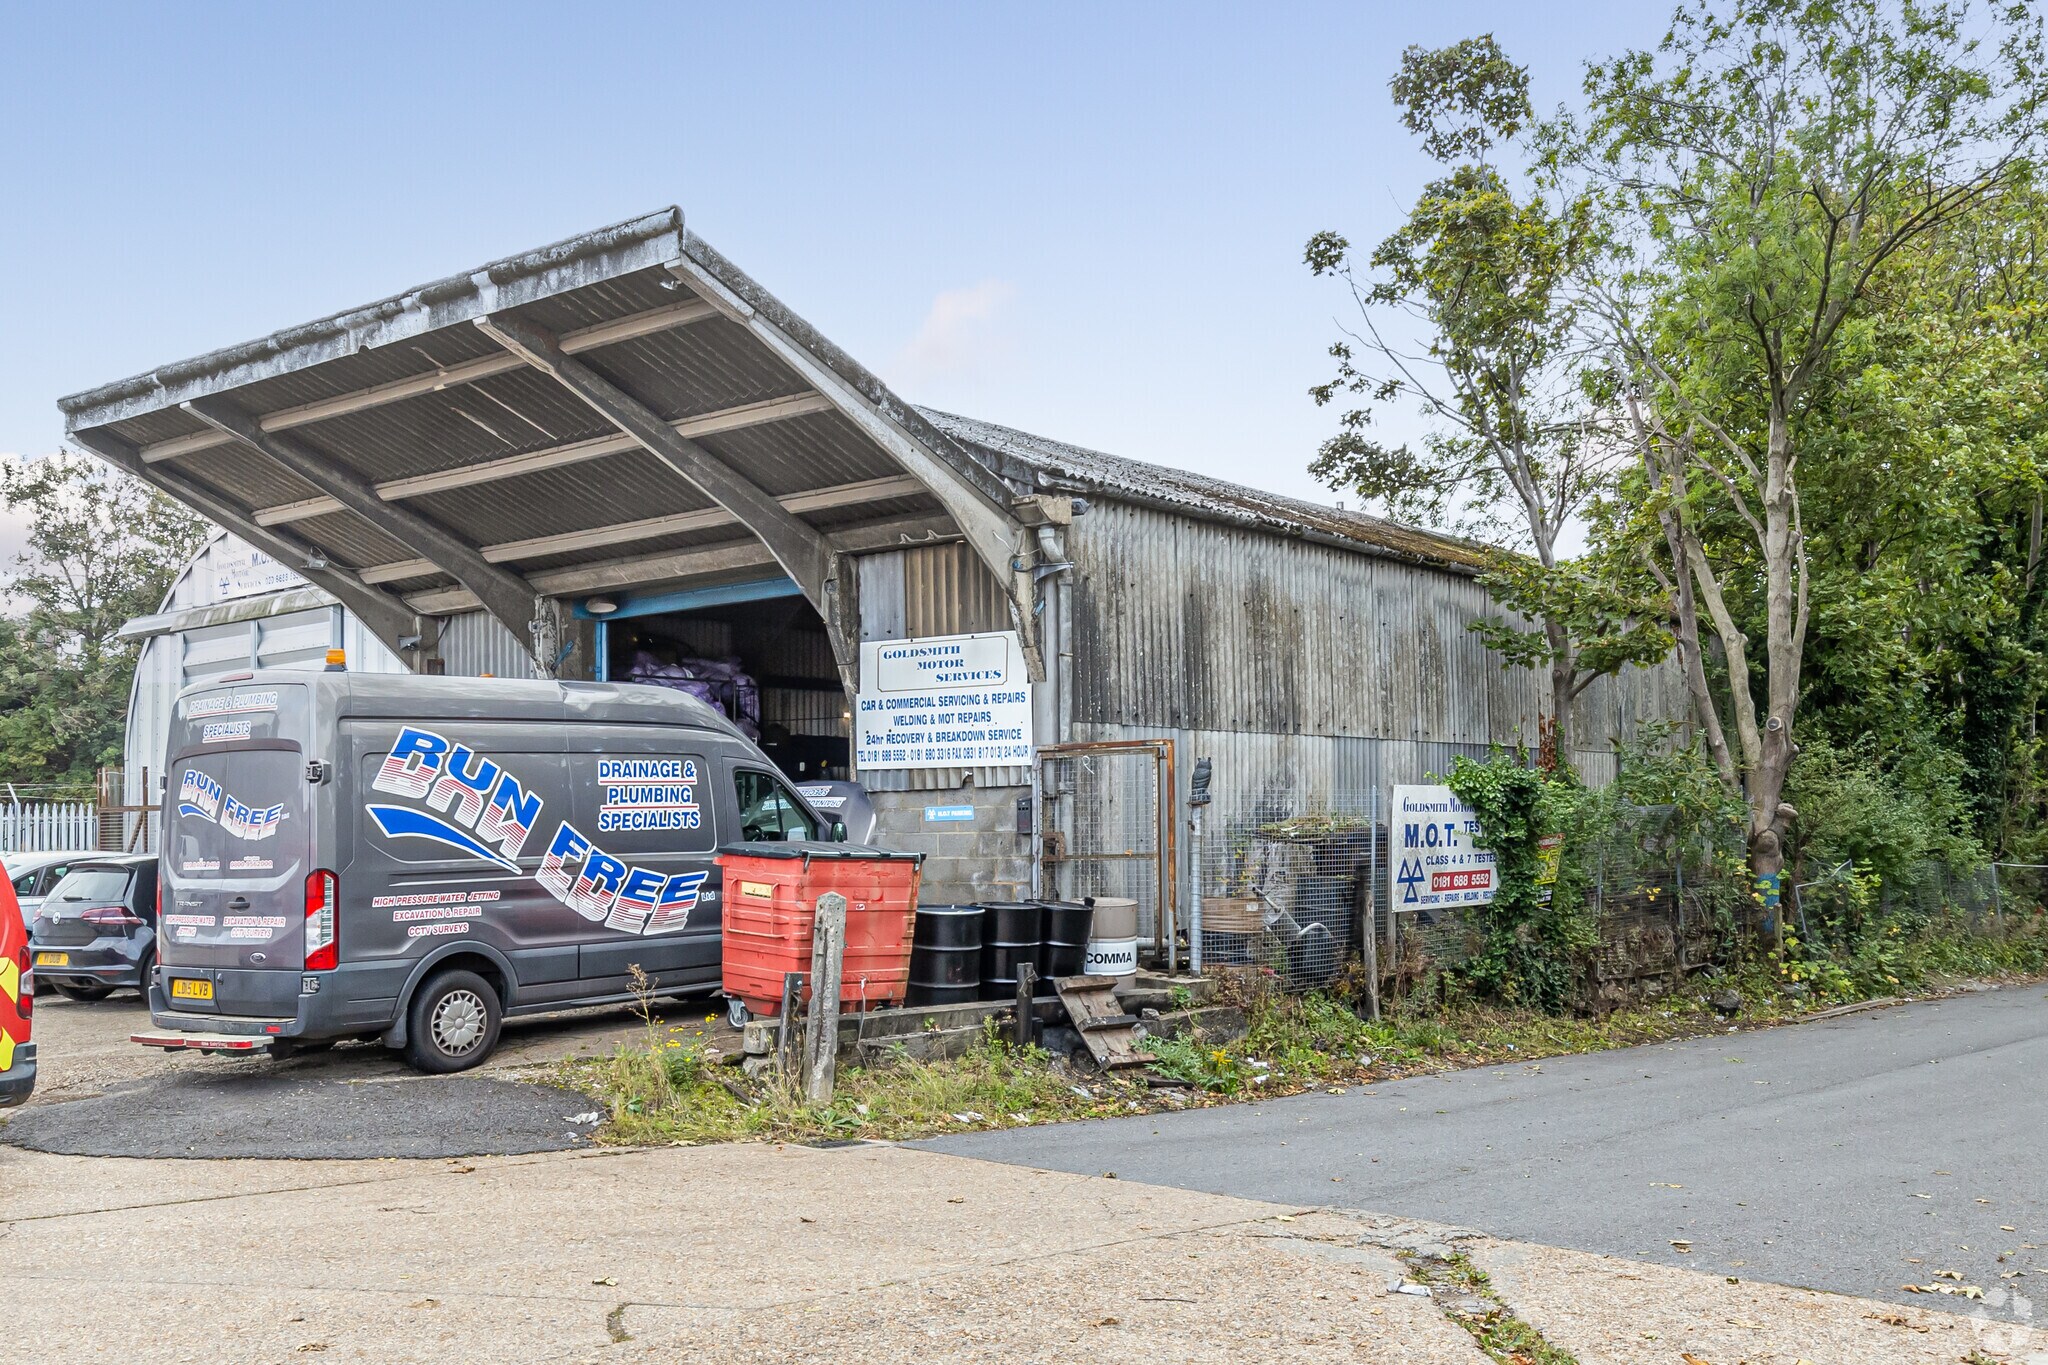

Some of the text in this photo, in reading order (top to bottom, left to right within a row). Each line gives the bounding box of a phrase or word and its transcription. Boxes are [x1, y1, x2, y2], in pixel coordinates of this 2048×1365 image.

[883, 645, 961, 660] GOLDSMITH
[917, 659, 965, 670] MOTOR
[935, 670, 1002, 683] SERVICES
[190, 692, 277, 713] DRAINAGE & PLUMBING
[861, 691, 1026, 711] CAR & COMMERCIAL SERVICING & REPAIRS
[893, 711, 992, 727] WELDING & MOT REPAIRS
[203, 721, 251, 738] SPECIALISTS
[866, 728, 1022, 745] 24hr RECOVERY & BREAKDOWN SERVICE
[858, 750, 867, 762] TEL
[867, 749, 880, 762] 0181
[910, 748, 923, 761] 0181
[952, 747, 962, 760] FAX
[1013, 744, 1029, 758] HOUR
[599, 761, 696, 779] DRAINAGE &
[182, 770, 284, 832] RUN FREE
[608, 786, 692, 804] PLUMBING
[1403, 797, 1447, 812] GOLDSMITH
[378, 727, 716, 920] RUN FREE Ltd
[599, 811, 700, 831] SPECIALISTS
[1405, 823, 1457, 848] M.O.T.
[1426, 855, 1448, 866] CLASS
[1452, 855, 1456, 864] 4
[1459, 854, 1464, 864] &
[1468, 854, 1472, 864] 7
[1433, 873, 1489, 888] 0181 688 5552
[373, 891, 499, 906] HIGH PRESSURE WATER JETTING
[1421, 895, 1440, 904] SERVICING
[1444, 893, 1459, 902] REPAIRS
[1464, 891, 1479, 900] WELDING
[394, 911, 443, 920] EXCAVATION
[453, 907, 481, 916] REPAIR
[224, 917, 256, 926] EXCAVATION
[263, 917, 286, 926] REPAIR
[246, 929, 272, 938] SURVEYS
[408, 924, 468, 935] CCTV SURVEYS
[1087, 952, 1132, 964] COMMA
[177, 981, 208, 996] LD15 LVB
